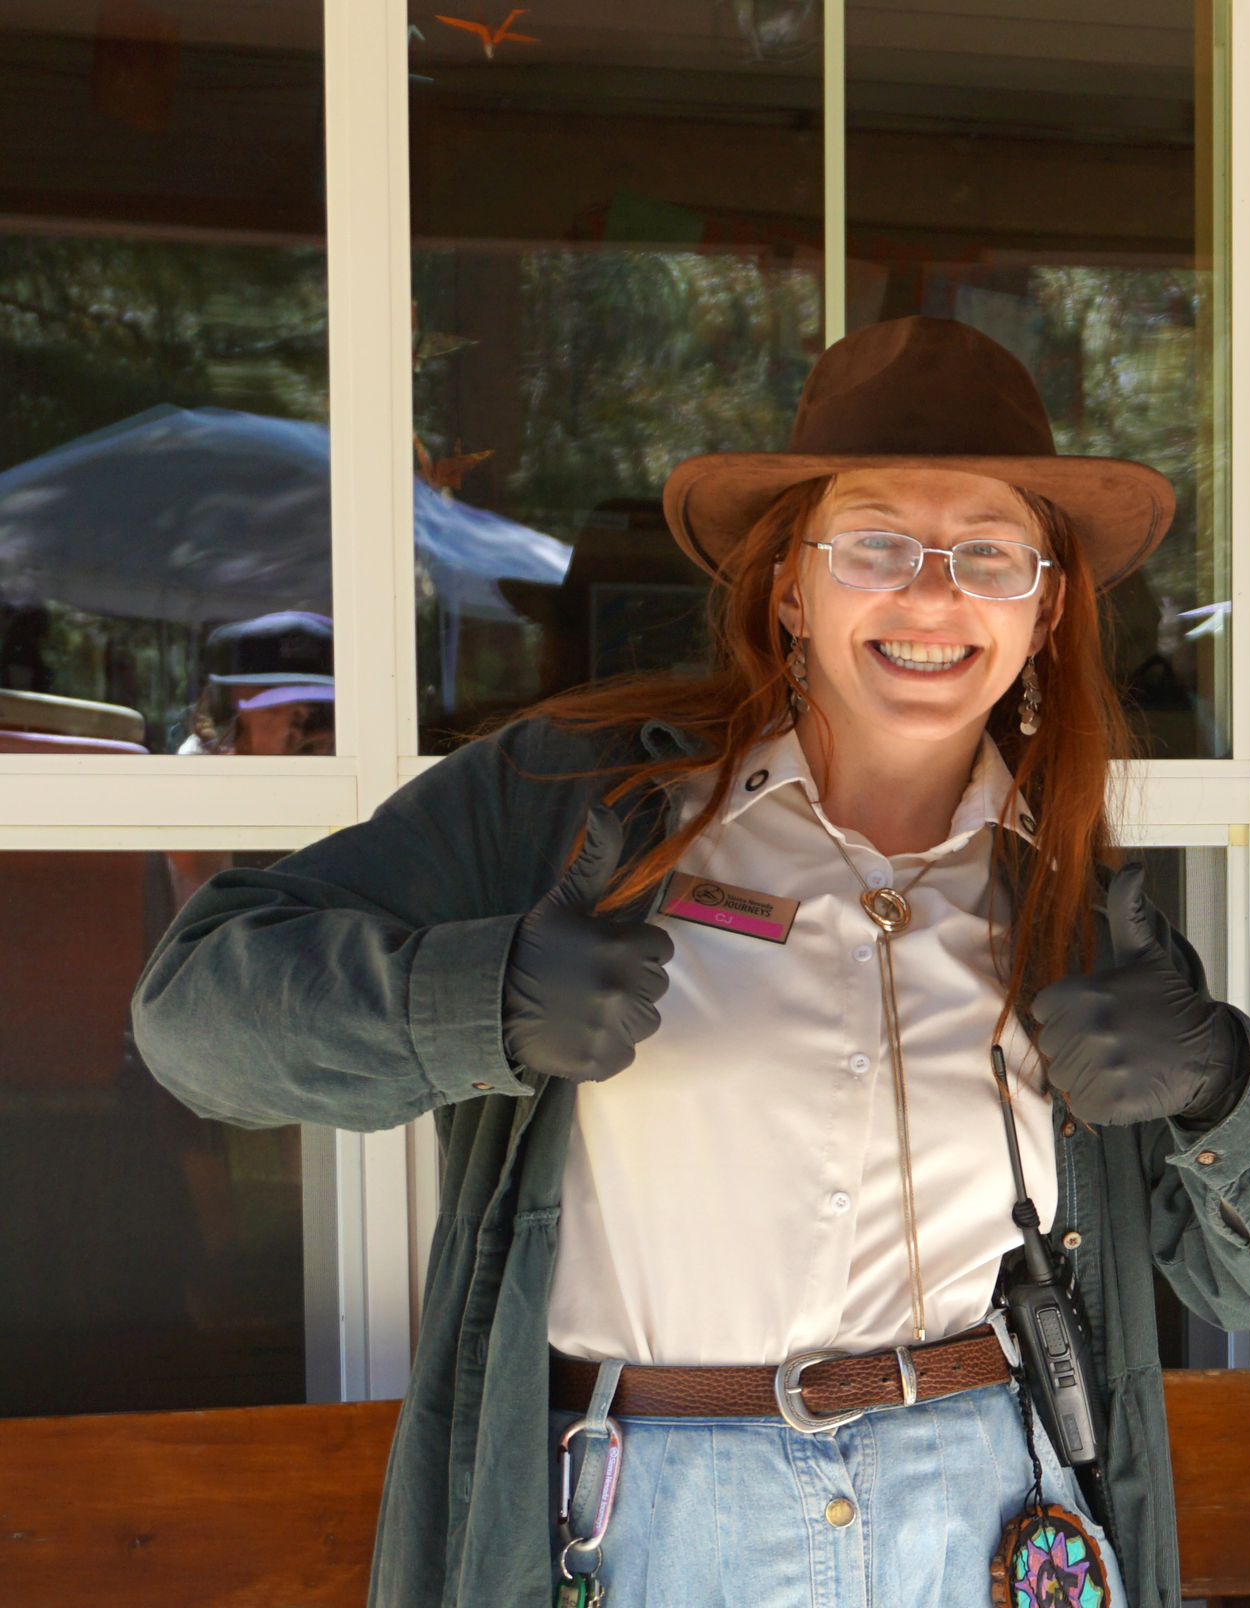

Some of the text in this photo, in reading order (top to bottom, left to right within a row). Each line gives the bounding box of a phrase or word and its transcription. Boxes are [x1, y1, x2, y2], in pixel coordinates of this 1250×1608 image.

[722, 900, 771, 917] JOURNEYS
[727, 894, 773, 910] Sierra Nevada
[715, 913, 733, 924] CJ
[606, 1457, 615, 1475] Sierra
[602, 1476, 612, 1500] Nevada
